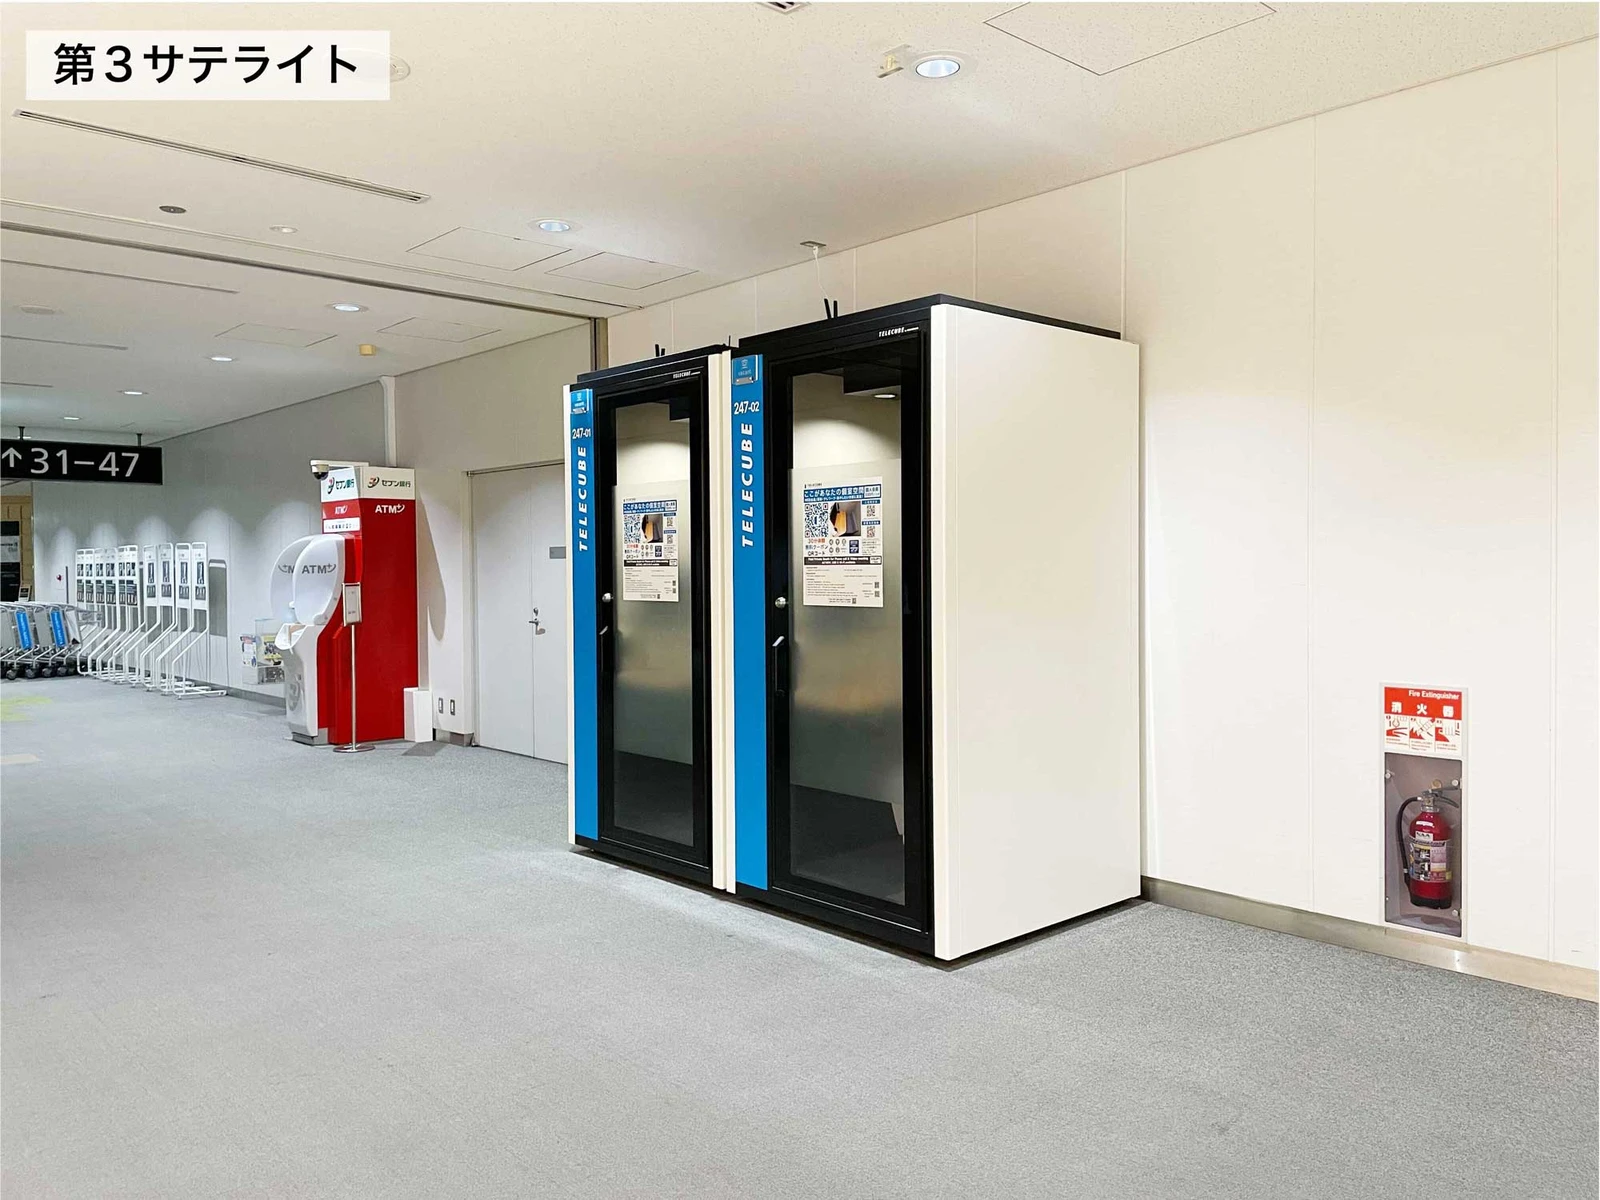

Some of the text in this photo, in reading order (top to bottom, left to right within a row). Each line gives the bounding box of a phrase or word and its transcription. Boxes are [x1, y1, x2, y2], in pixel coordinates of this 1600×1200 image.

[734, 400, 760, 414] 247-02
[572, 427, 592, 440] 247-01
[336, 478, 355, 490] セブン銀行
[382, 480, 412, 488] セブン銀行
[741, 423, 754, 548] TELECUBE
[578, 446, 588, 552] TELECUBE
[374, 505, 397, 514] ATM
[302, 564, 327, 574] ATM
[1408, 690, 1460, 700] Fire Extinguisher
[1392, 701, 1454, 718] 消火器
